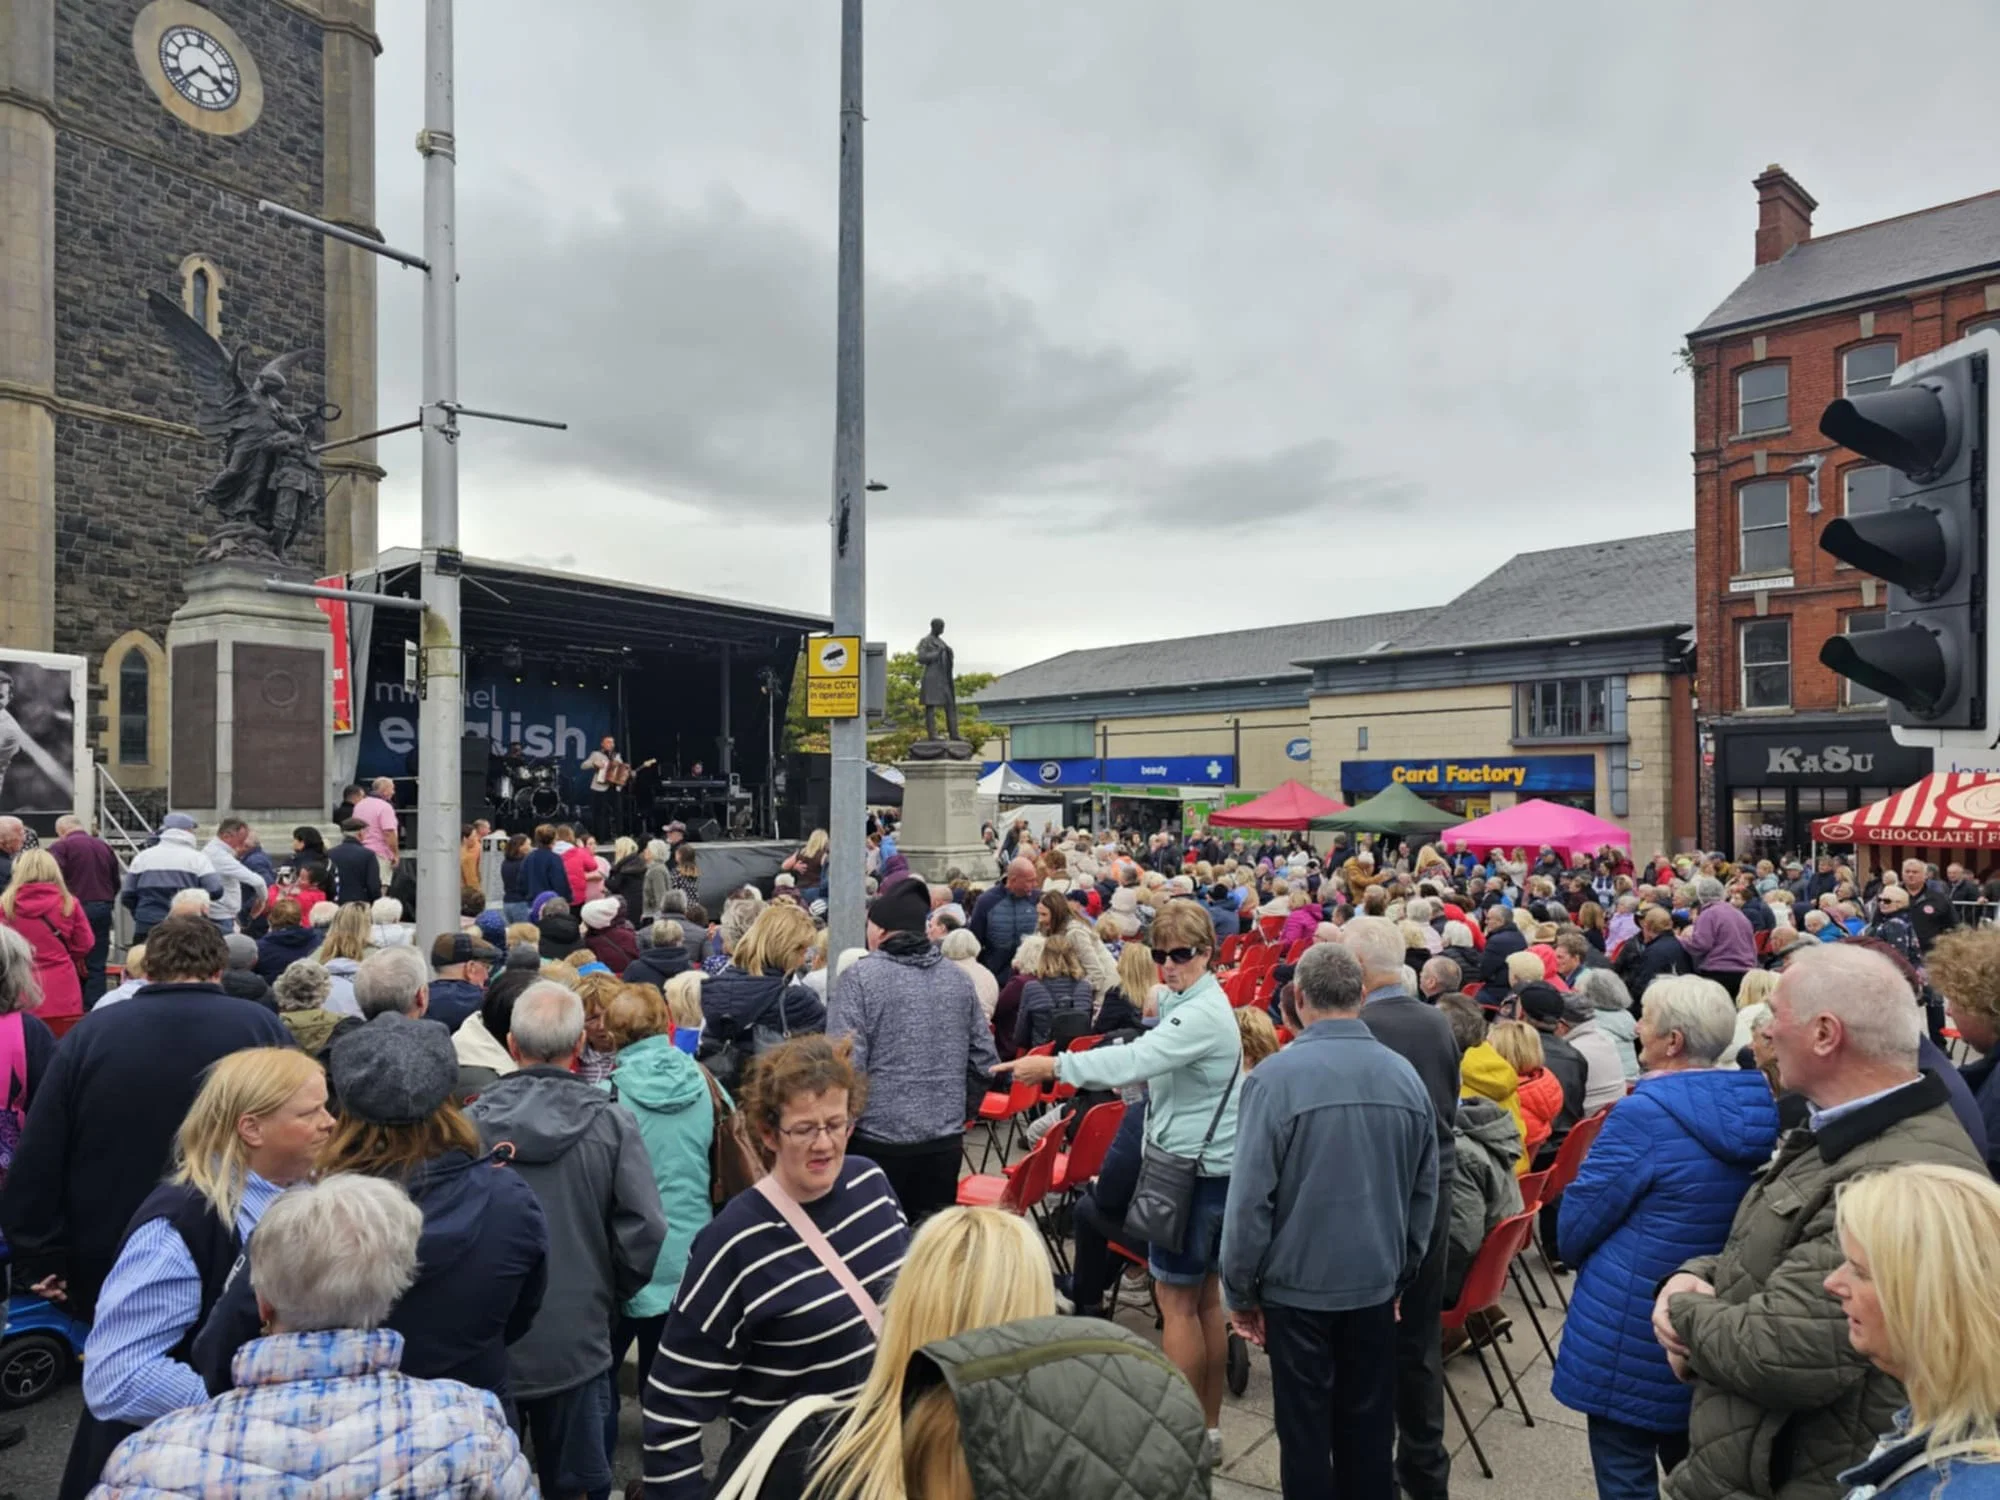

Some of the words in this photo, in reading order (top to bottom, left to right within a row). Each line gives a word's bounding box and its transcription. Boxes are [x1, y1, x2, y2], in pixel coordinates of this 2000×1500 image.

[834, 681, 857, 690] CCTV
[820, 692, 856, 700] operation
[1392, 765, 1439, 783] Card
[1446, 764, 1526, 786] Factory
[1868, 828, 1975, 844] CHOCOLATE
